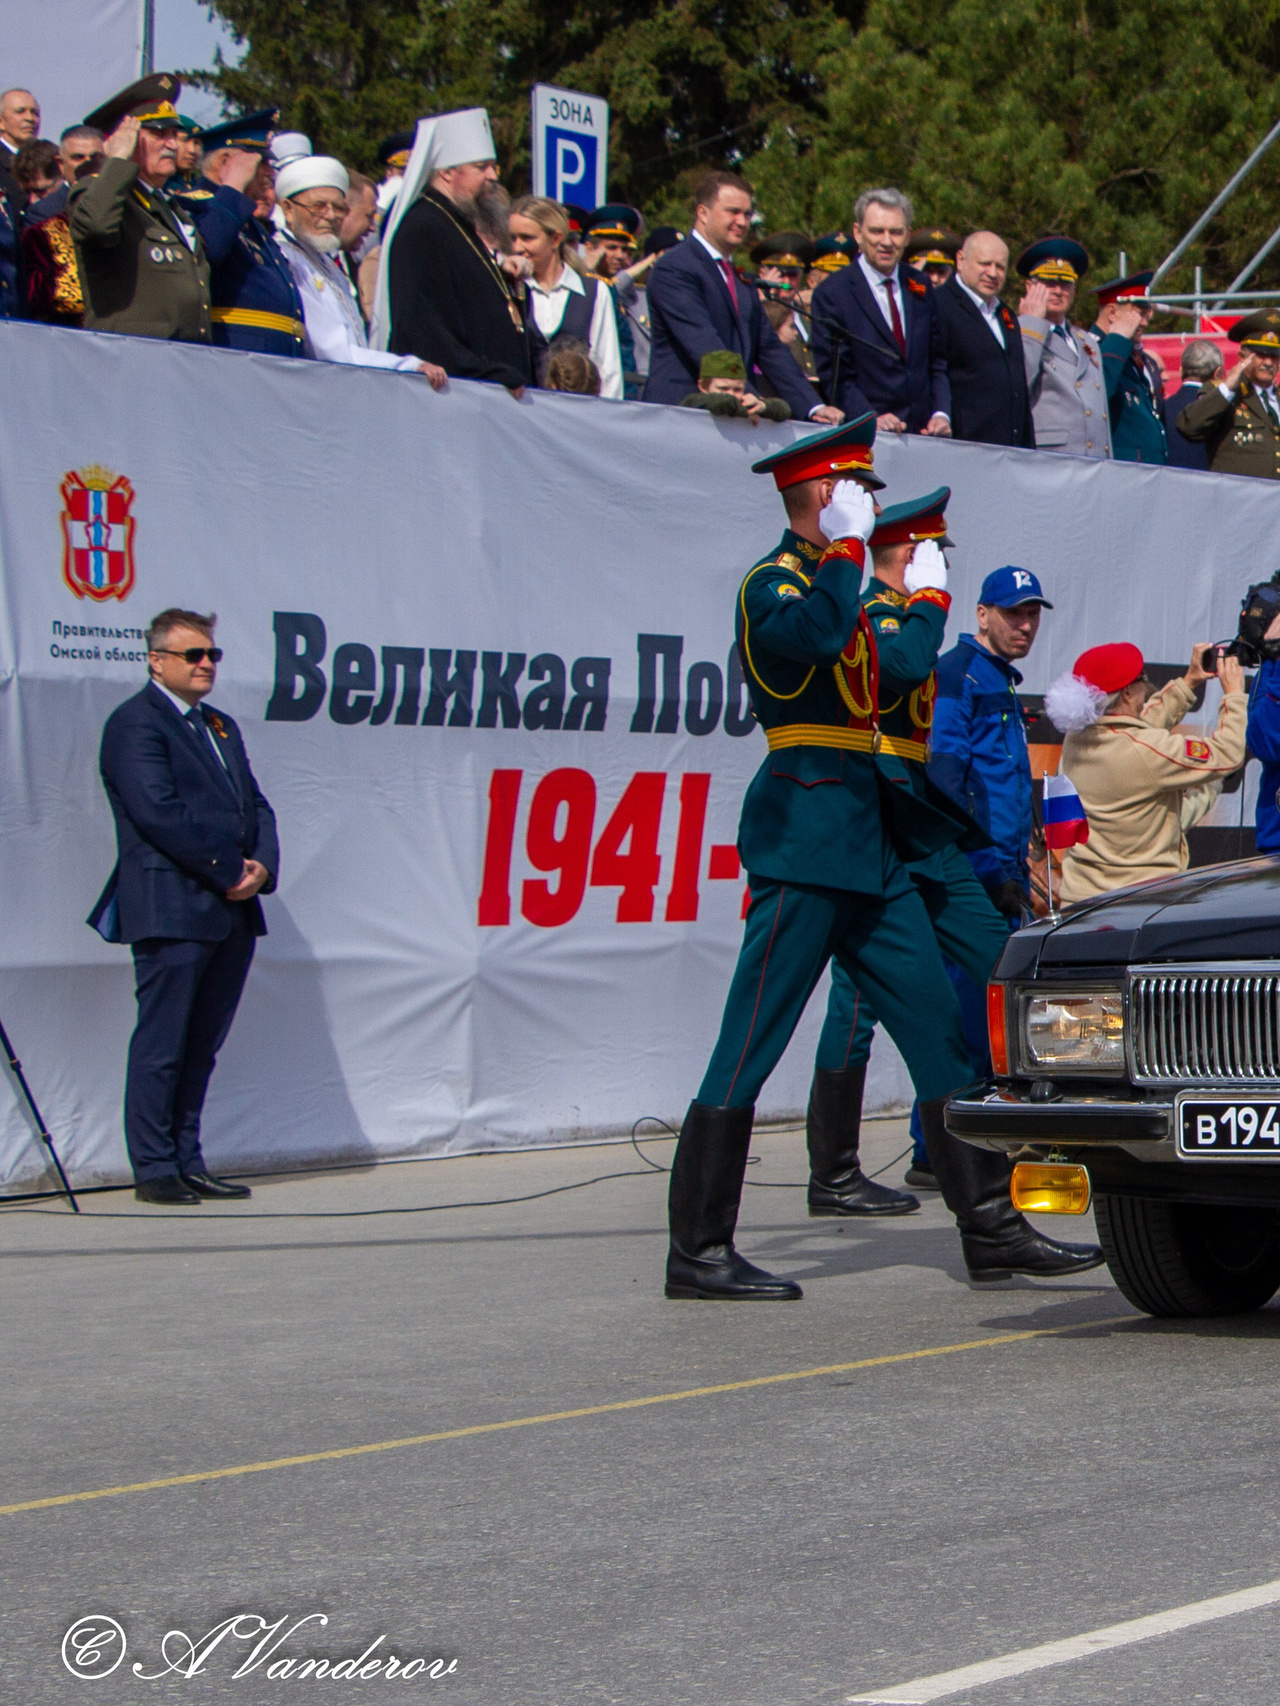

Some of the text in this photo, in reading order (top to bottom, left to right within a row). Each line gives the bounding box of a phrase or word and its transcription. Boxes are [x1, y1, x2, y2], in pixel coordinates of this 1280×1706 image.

[549, 97, 594, 127] ЗОНА
[51, 643, 148, 662] Омской област
[265, 611, 757, 737] Великая Поб
[478, 767, 752, 928] 1941-
